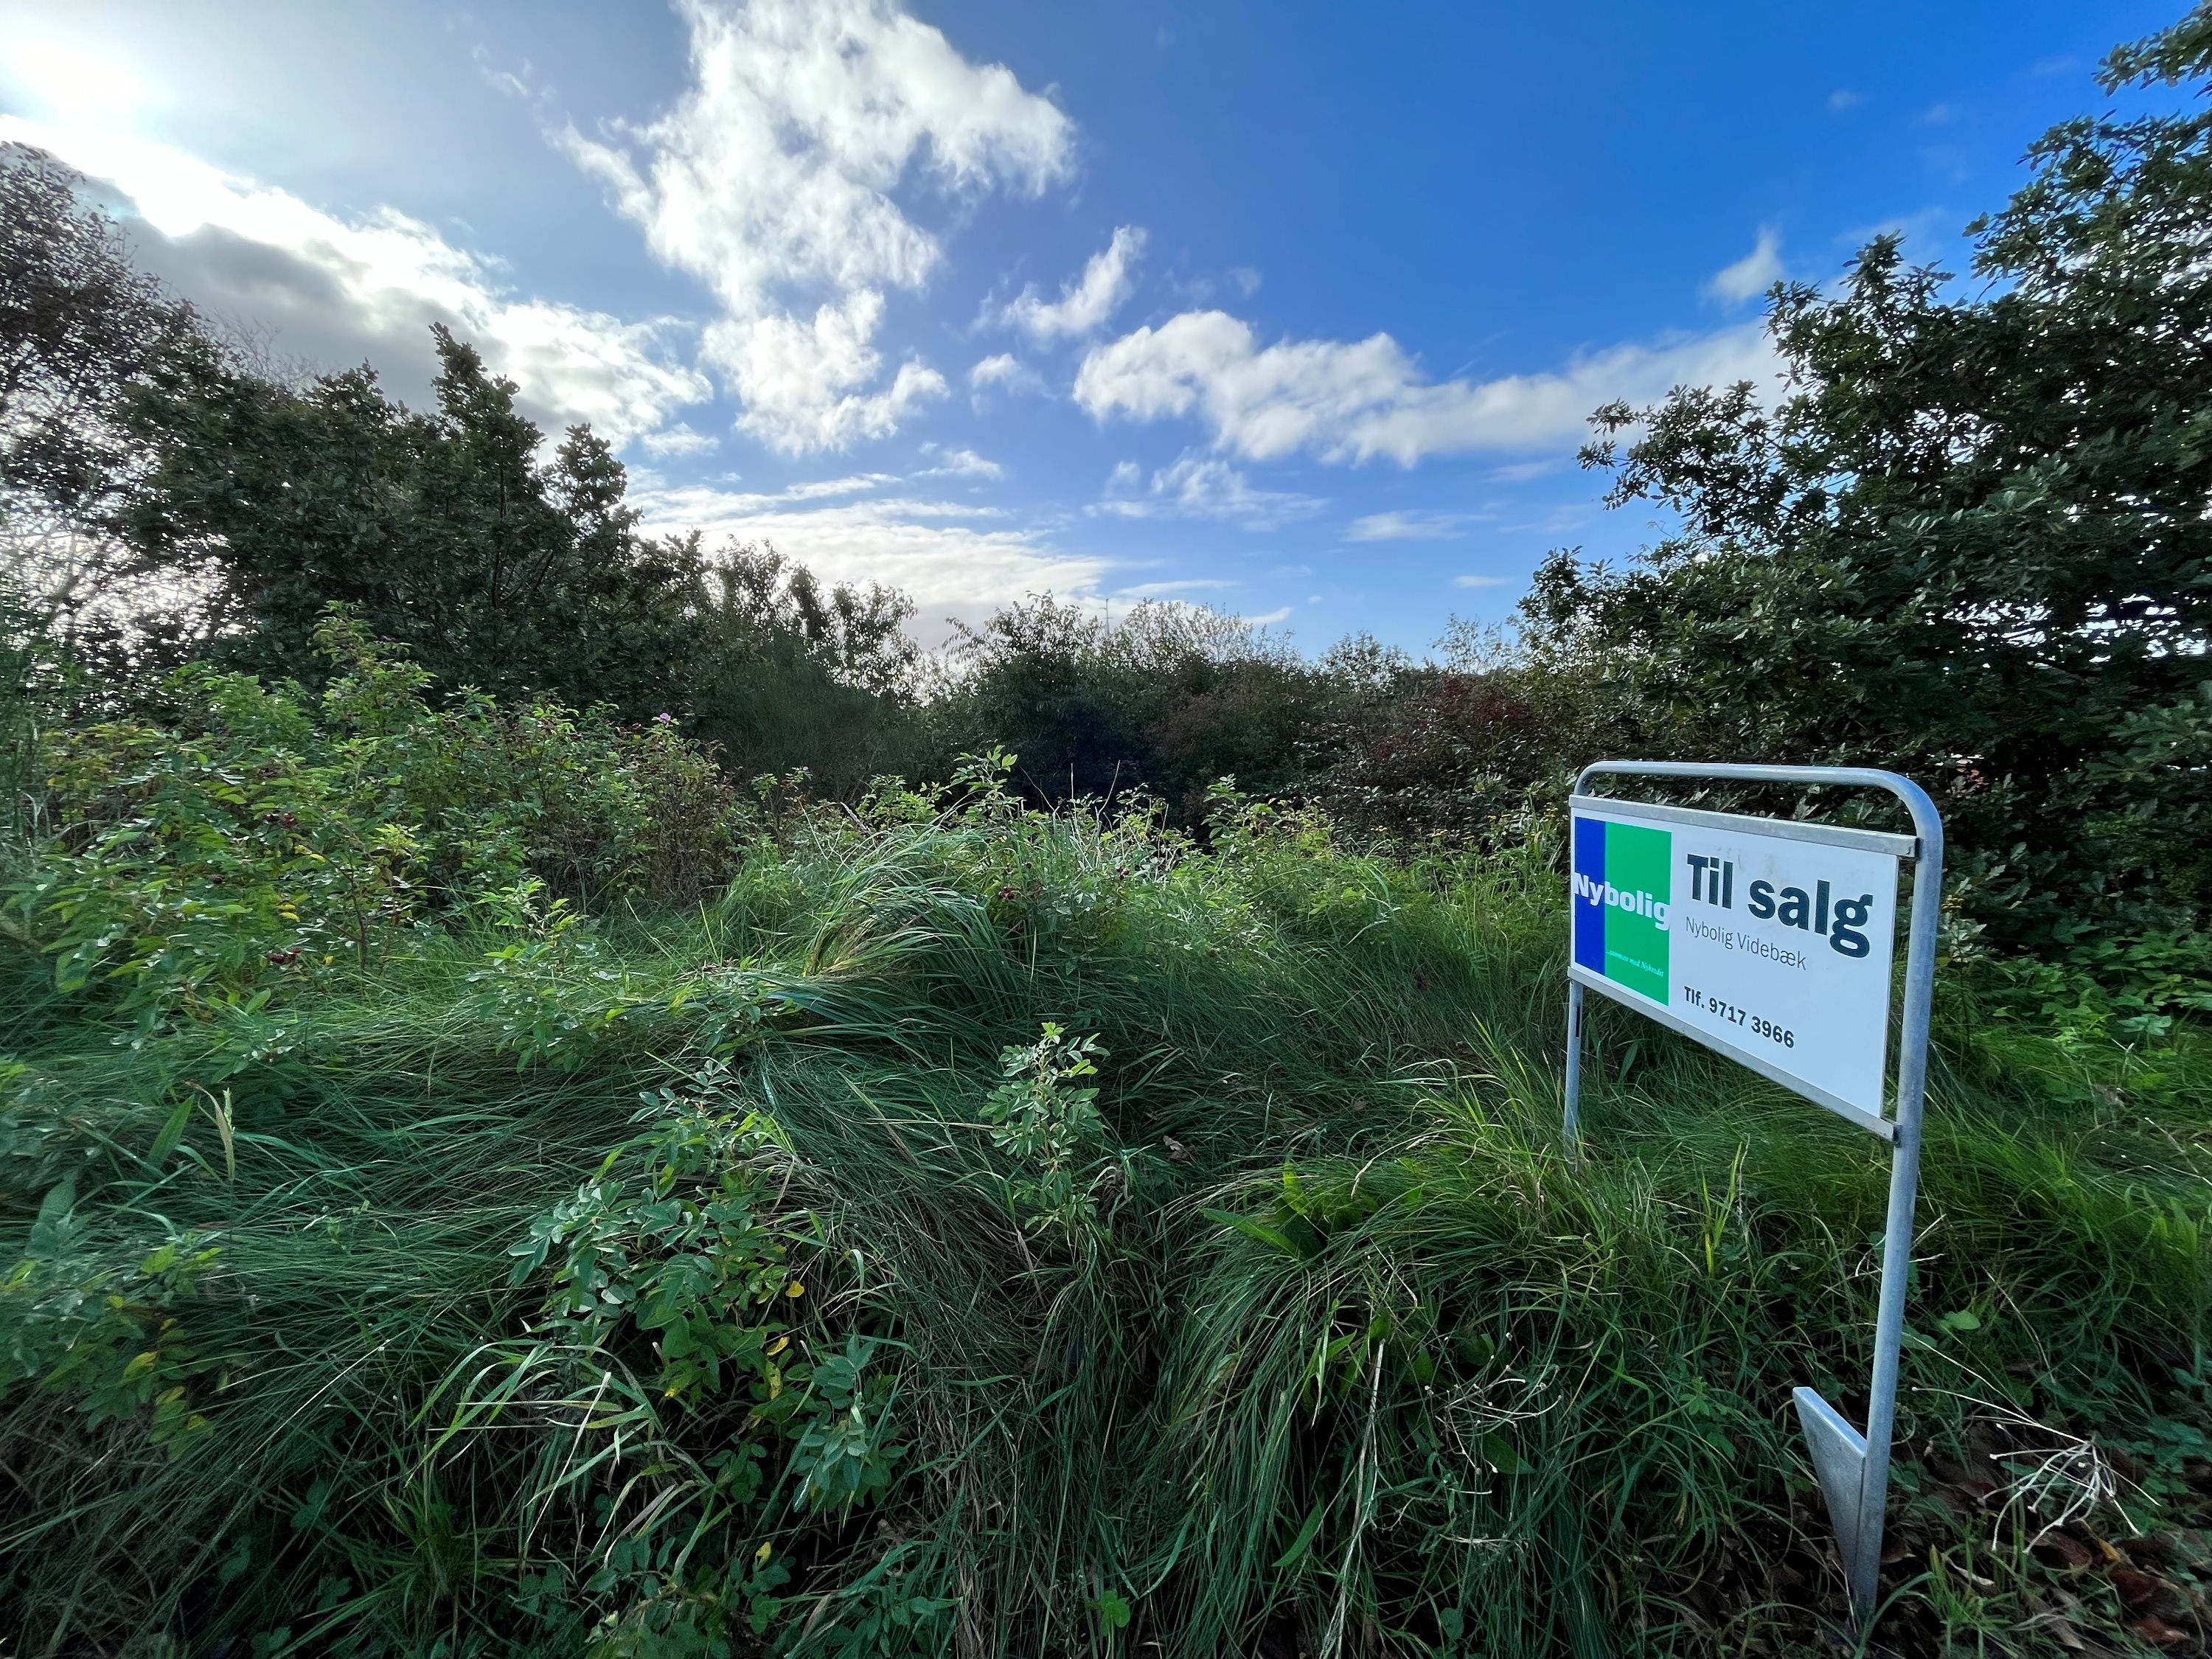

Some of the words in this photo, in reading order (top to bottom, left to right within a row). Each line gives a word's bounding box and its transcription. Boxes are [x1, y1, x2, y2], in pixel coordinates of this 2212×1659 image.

[1573, 872, 1672, 931] Nybolig
[1687, 854, 1733, 910] Til
[1747, 880, 1874, 958] salg
[1686, 917, 1733, 950] Nybolig
[1736, 932, 1806, 971] Videbæk
[1684, 986, 1705, 1008] Tlf.
[1709, 998, 1747, 1026] 9717
[1752, 1015, 1794, 1048] 3966
